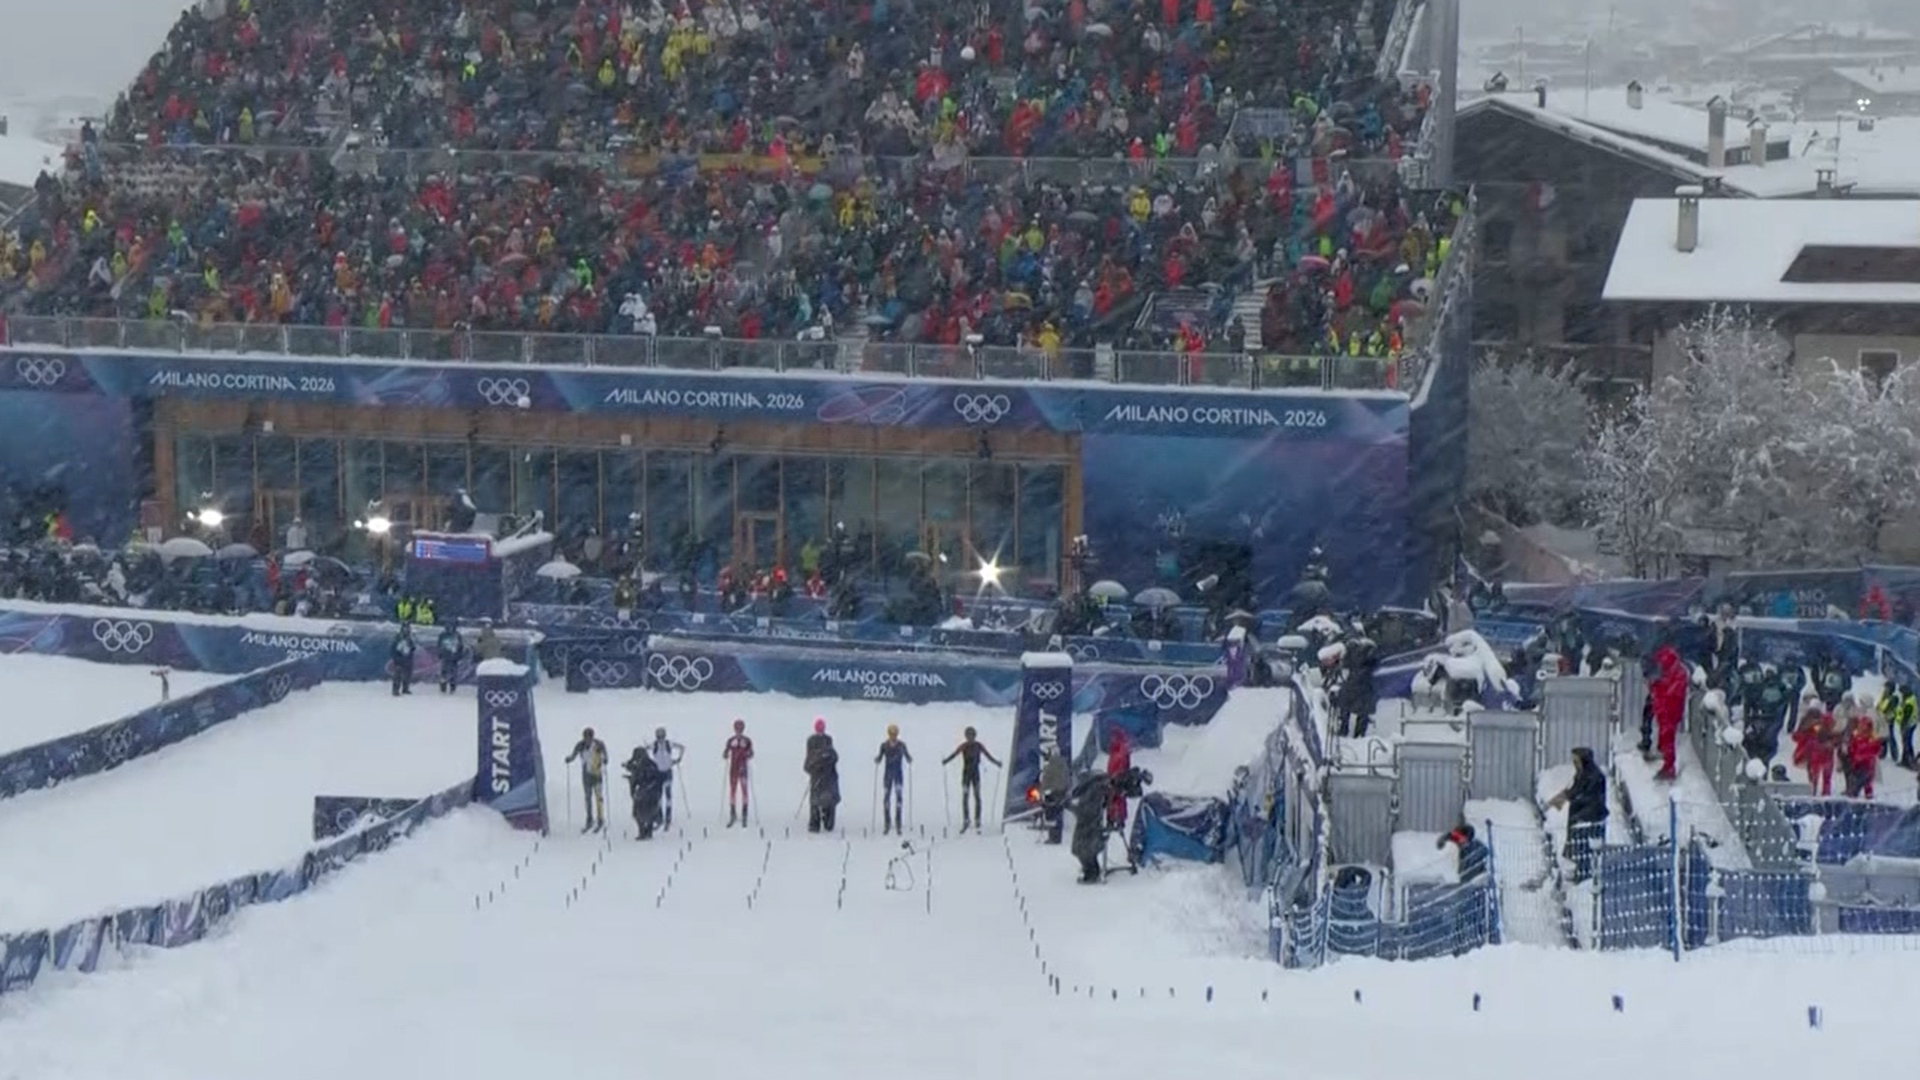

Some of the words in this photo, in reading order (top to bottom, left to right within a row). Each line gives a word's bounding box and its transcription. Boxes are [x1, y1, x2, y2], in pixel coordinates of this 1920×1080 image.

[150, 371, 221, 388] MILANO
[223, 374, 297, 391] CORTINA
[300, 377, 336, 392] 2026
[604, 388, 681, 405] MILANO
[683, 391, 763, 408] CORTINA
[767, 393, 804, 409] 2026
[1104, 404, 1189, 423] MILANO
[1192, 407, 1281, 426] CORTINA
[1284, 410, 1327, 427] 2026
[240, 631, 299, 649] MILANO
[301, 638, 361, 653] CORTINA
[811, 668, 877, 684] MILANO
[879, 671, 947, 687] CORTINA
[863, 684, 895, 699] 2026
[491, 716, 511, 795] START
[1039, 708, 1060, 782] ART
